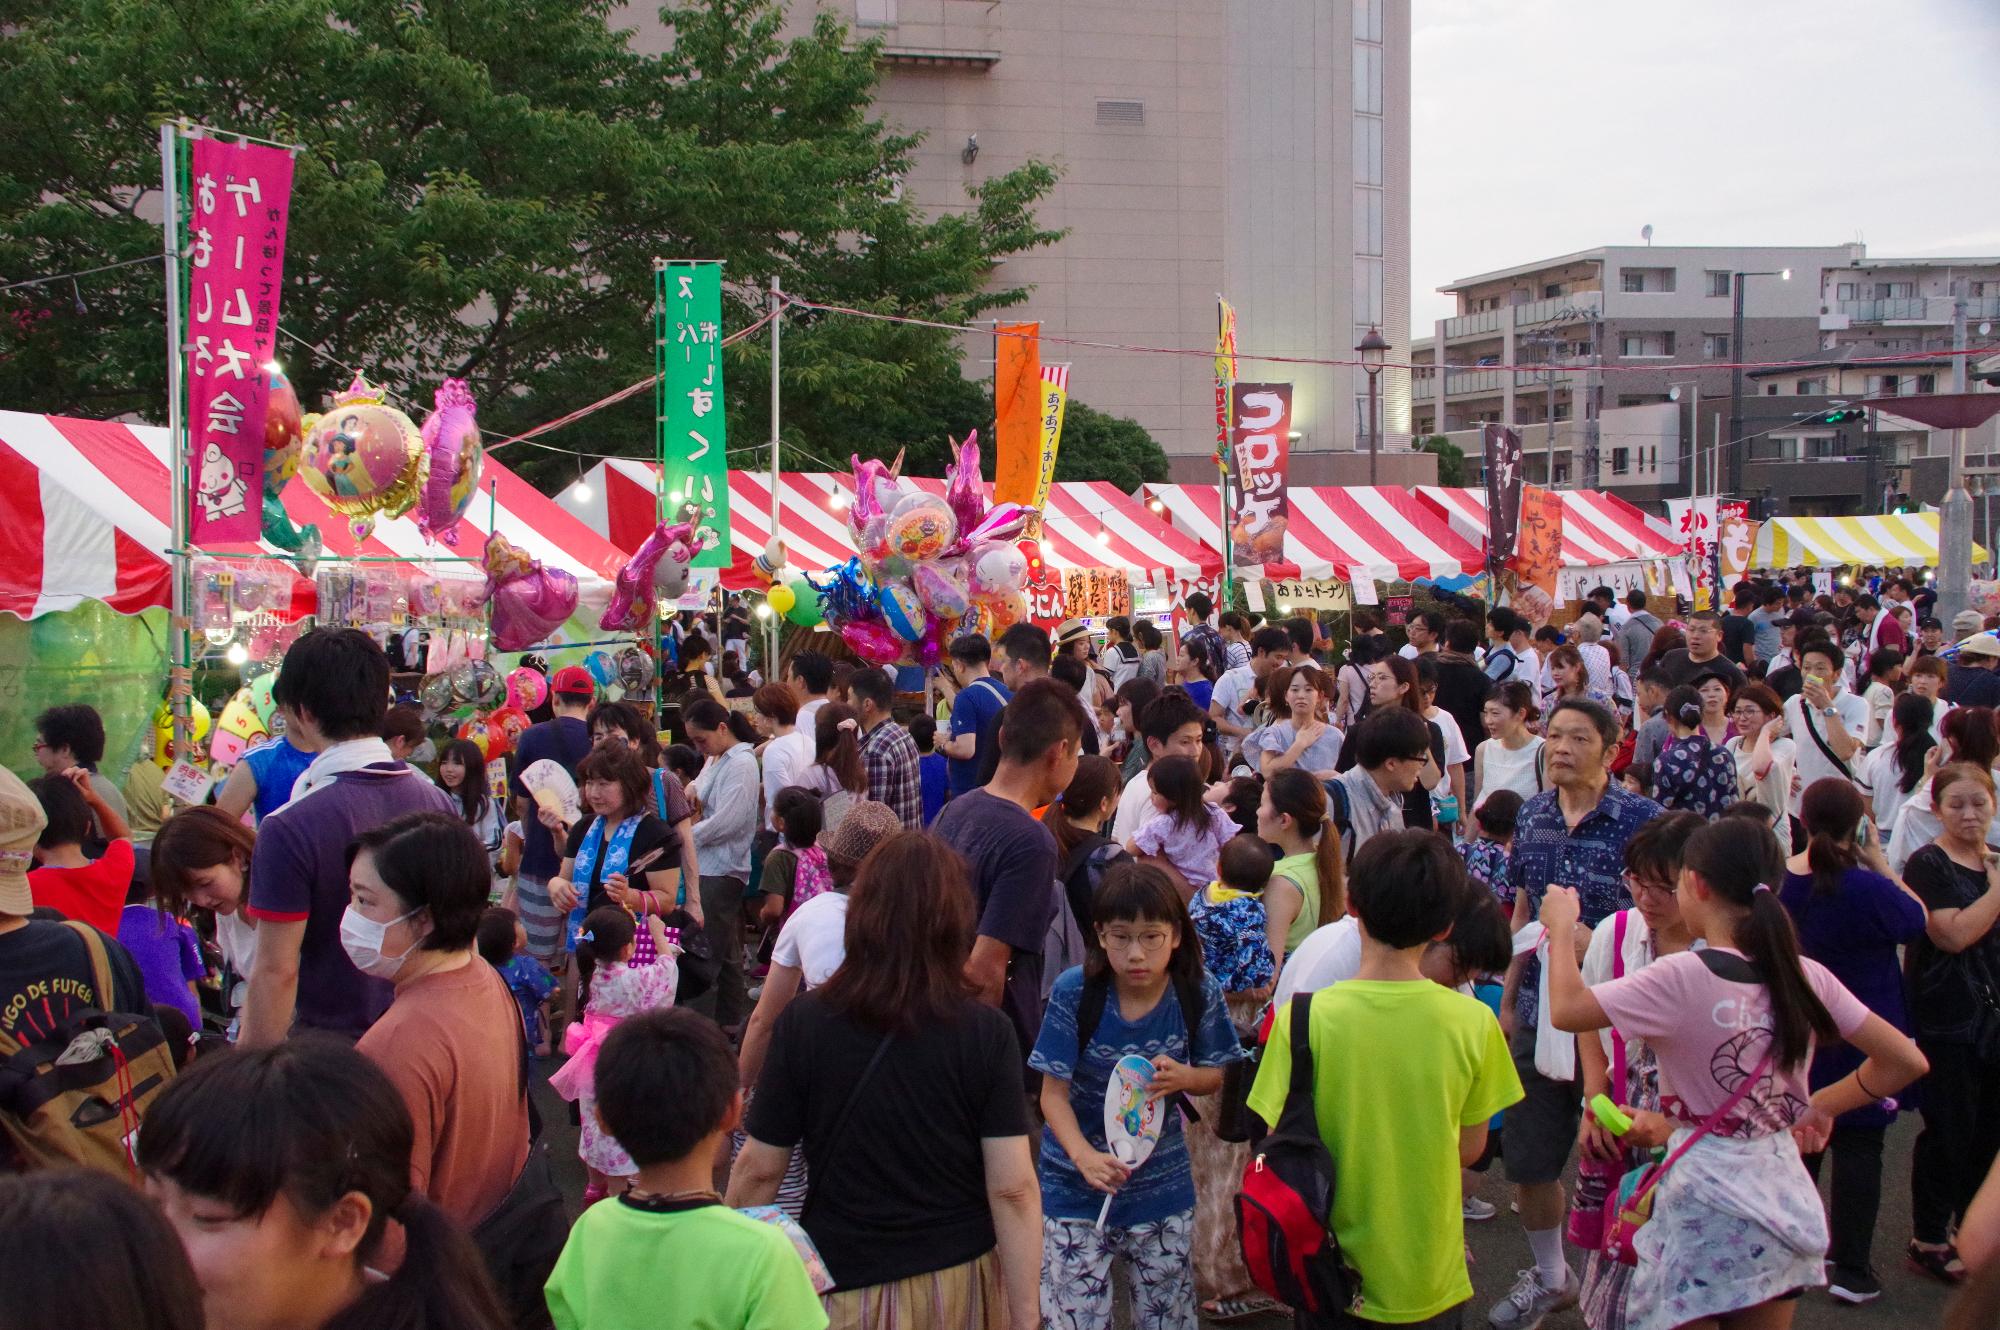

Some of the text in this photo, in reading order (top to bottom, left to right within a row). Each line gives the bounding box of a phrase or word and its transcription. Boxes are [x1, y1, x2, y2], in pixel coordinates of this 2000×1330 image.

[1038, 392, 1060, 507] あつあつ!おいしい!
[1238, 391, 1285, 535] コロッケ
[1238, 445, 1251, 488] サクサク
[264, 691, 271, 705] 3
[236, 716, 247, 728] 5
[27, 979, 49, 1000] DE
